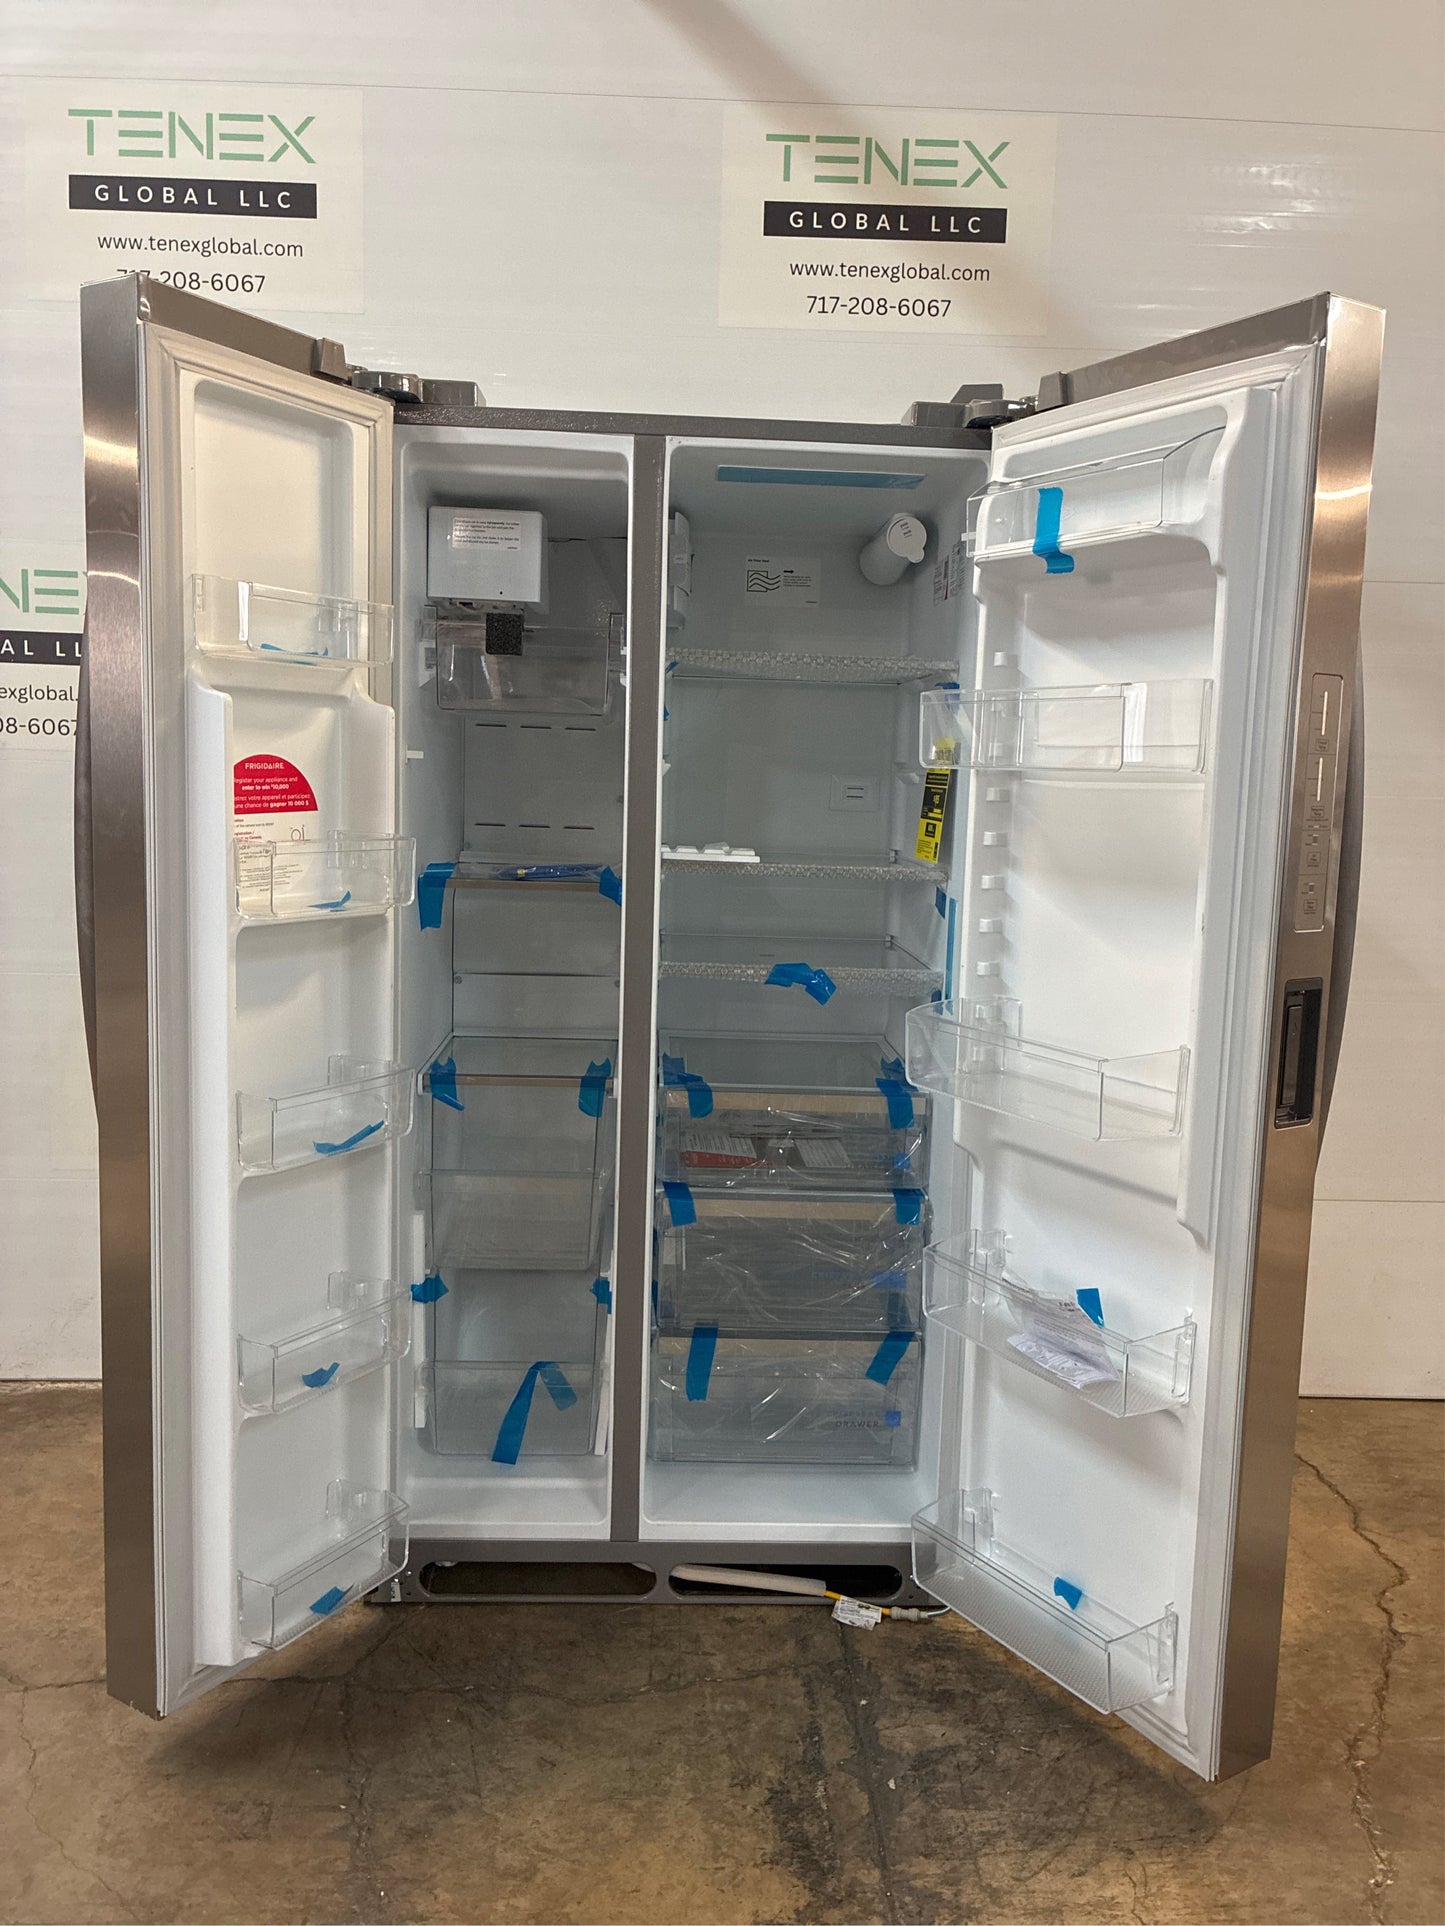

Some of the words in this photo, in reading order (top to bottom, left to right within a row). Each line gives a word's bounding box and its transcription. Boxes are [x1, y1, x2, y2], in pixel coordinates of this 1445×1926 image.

[68, 109, 316, 163] TENEX
[766, 133, 1010, 189] TENEX
[94, 184, 218, 206] GLOBAL
[239, 190, 292, 209] LLC
[789, 210, 909, 232] GLOBAL
[930, 215, 982, 233] LLC
[97, 235, 304, 258] www.tenexglobal.com
[116, 269, 266, 293] -208-6067
[789, 262, 991, 283] www.tenexglobal.com
[806, 295, 952, 318] 717-208-6067
[0, 569, 87, 615] NE
[0, 717, 77, 736] 8-606
[244, 762, 285, 770] FRIGIDAIRE
